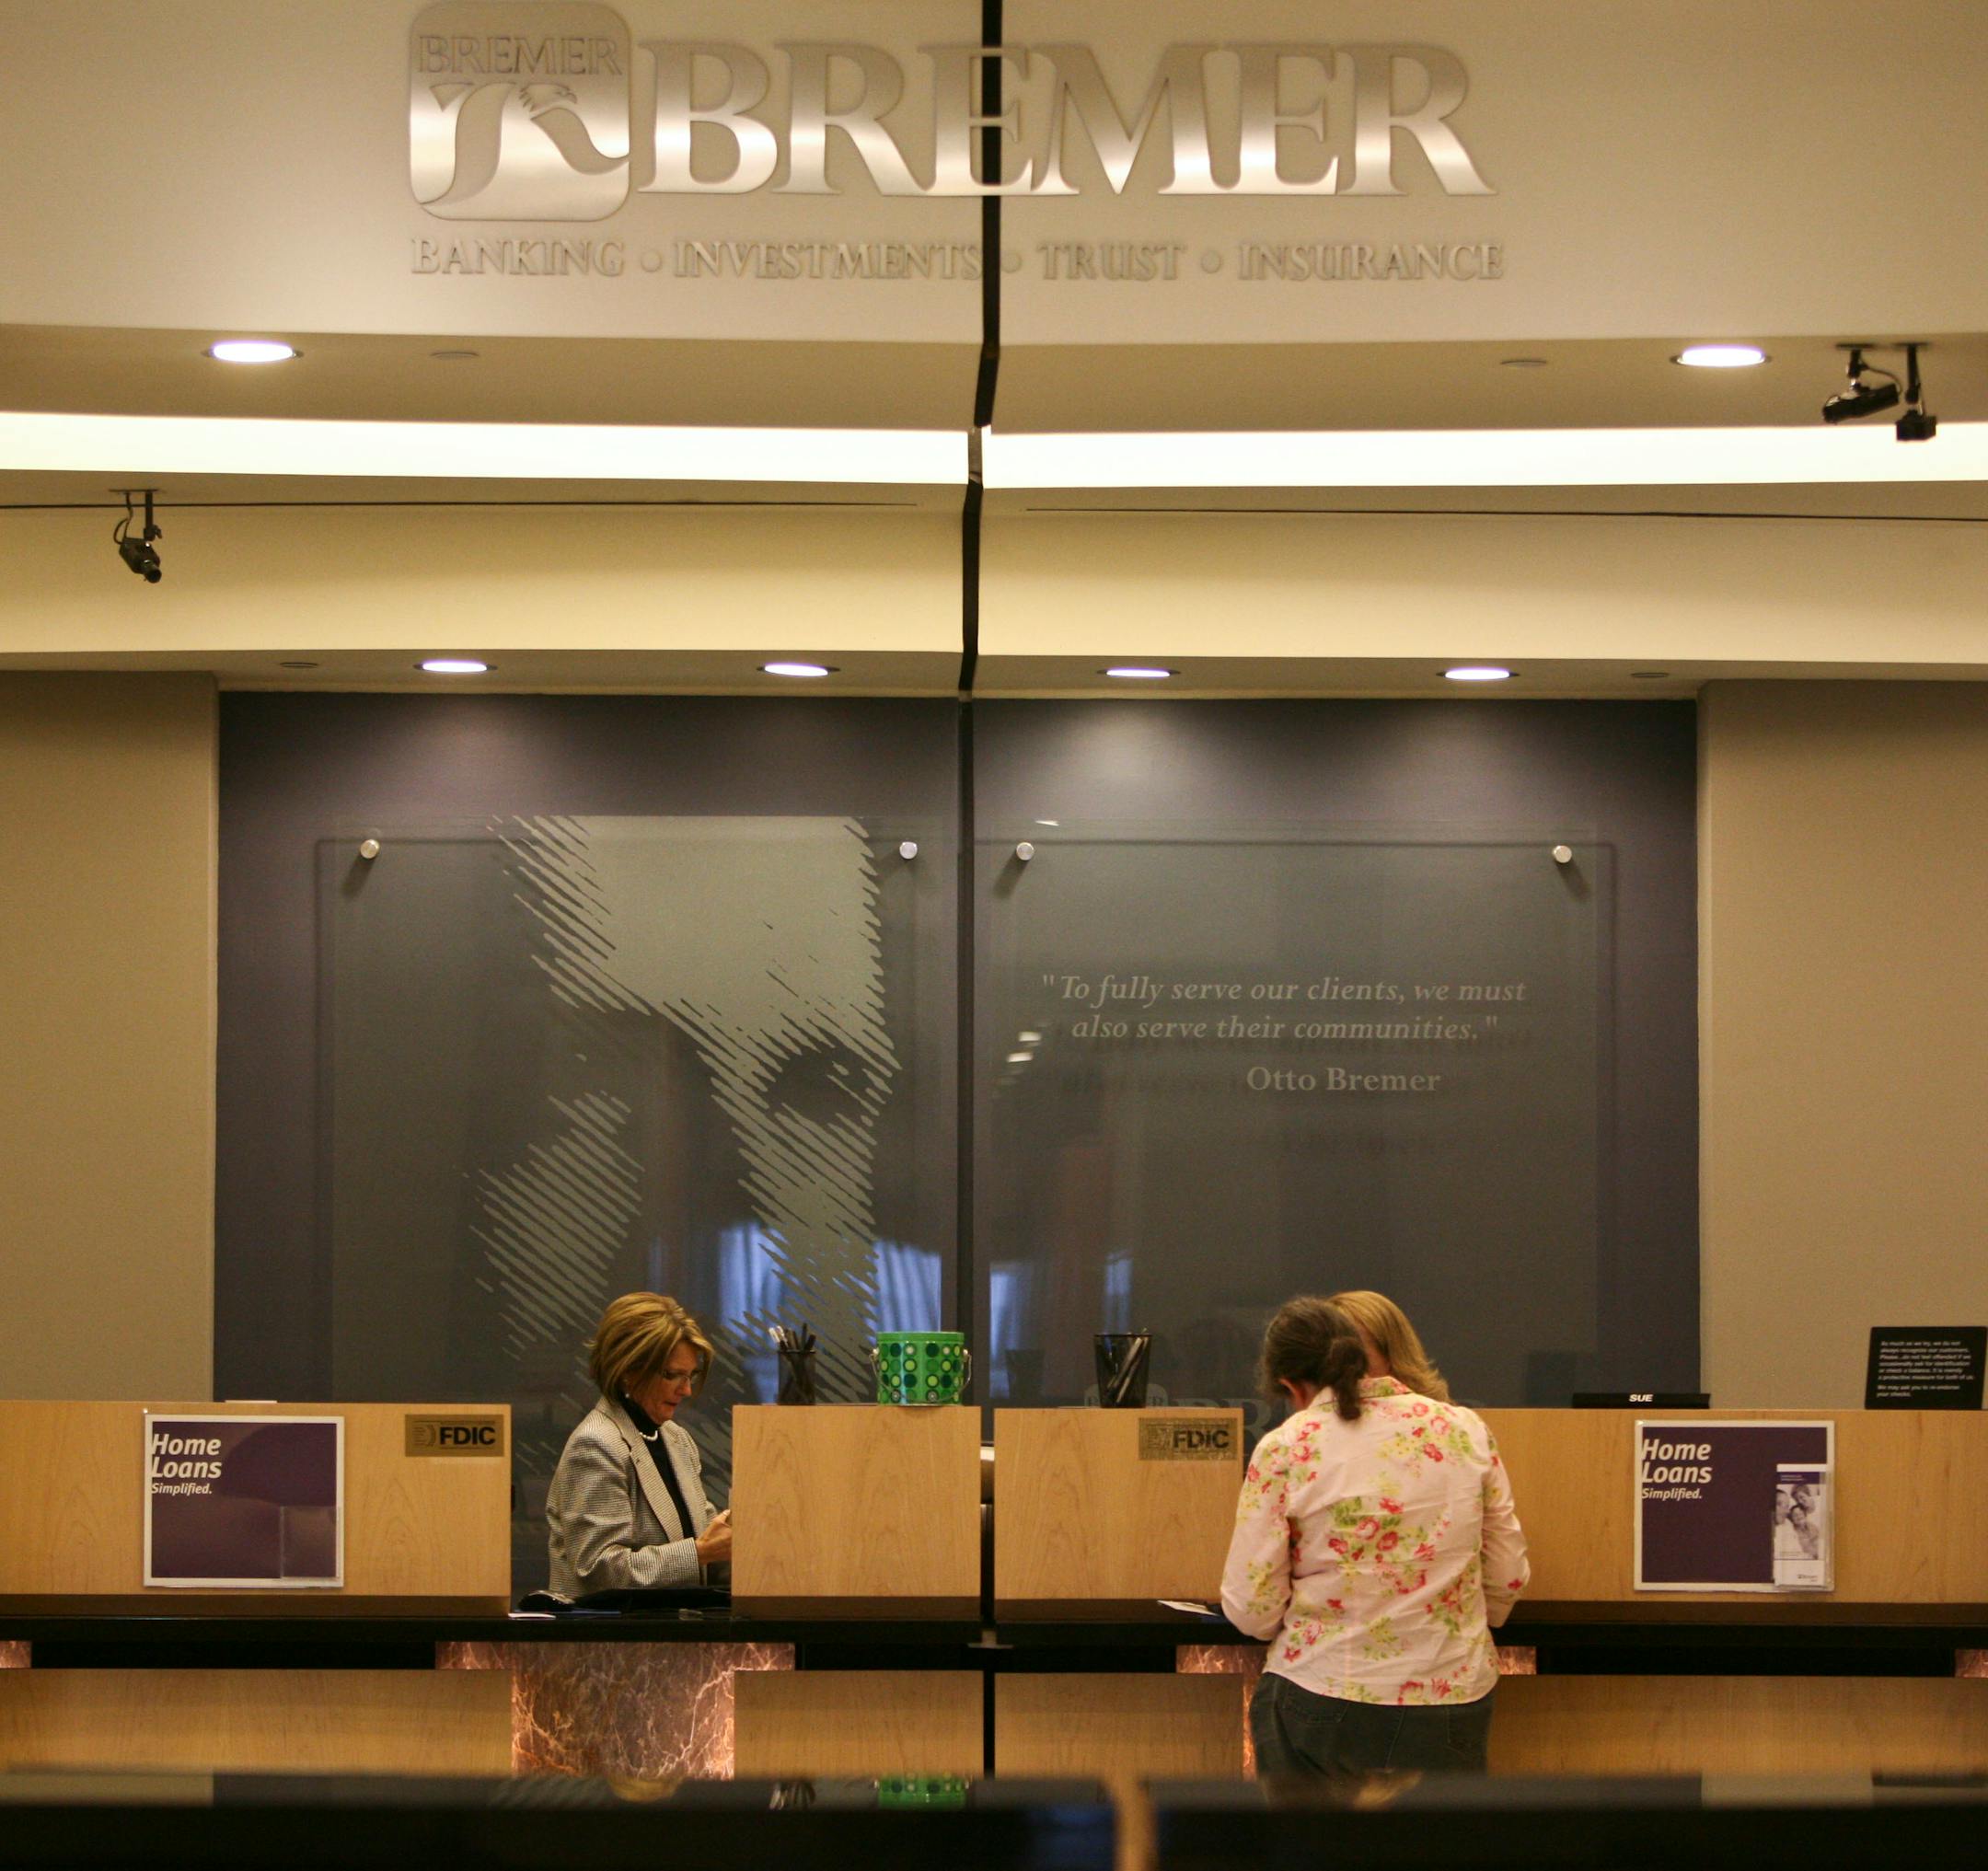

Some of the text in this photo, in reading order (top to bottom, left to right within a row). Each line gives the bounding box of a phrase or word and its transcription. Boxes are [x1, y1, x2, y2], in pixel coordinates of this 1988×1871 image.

[418, 35, 623, 75] BREMER
[637, 41, 1498, 196] BREMER
[410, 237, 1505, 281] BANKING INVESTMENTS TRUST INSURANCE
[1043, 975, 1527, 1010] "To fully serve our clients, we must
[1072, 1014, 1127, 1038] also
[1137, 1022, 1207, 1039] serve
[1217, 1015, 1287, 1039] their
[1246, 1067, 1442, 1091] Otto Bremer
[1629, 1393, 1654, 1403] SUE
[152, 1433, 222, 1456] Home
[440, 1426, 496, 1446] FDIC
[1173, 1430, 1229, 1449] FDIC
[1642, 1438, 1712, 1461] Home
[152, 1456, 223, 1479] Loans
[1642, 1461, 1713, 1484] Loans
[151, 1482, 213, 1496] Simplified.
[1641, 1487, 1703, 1501] Simplified.
